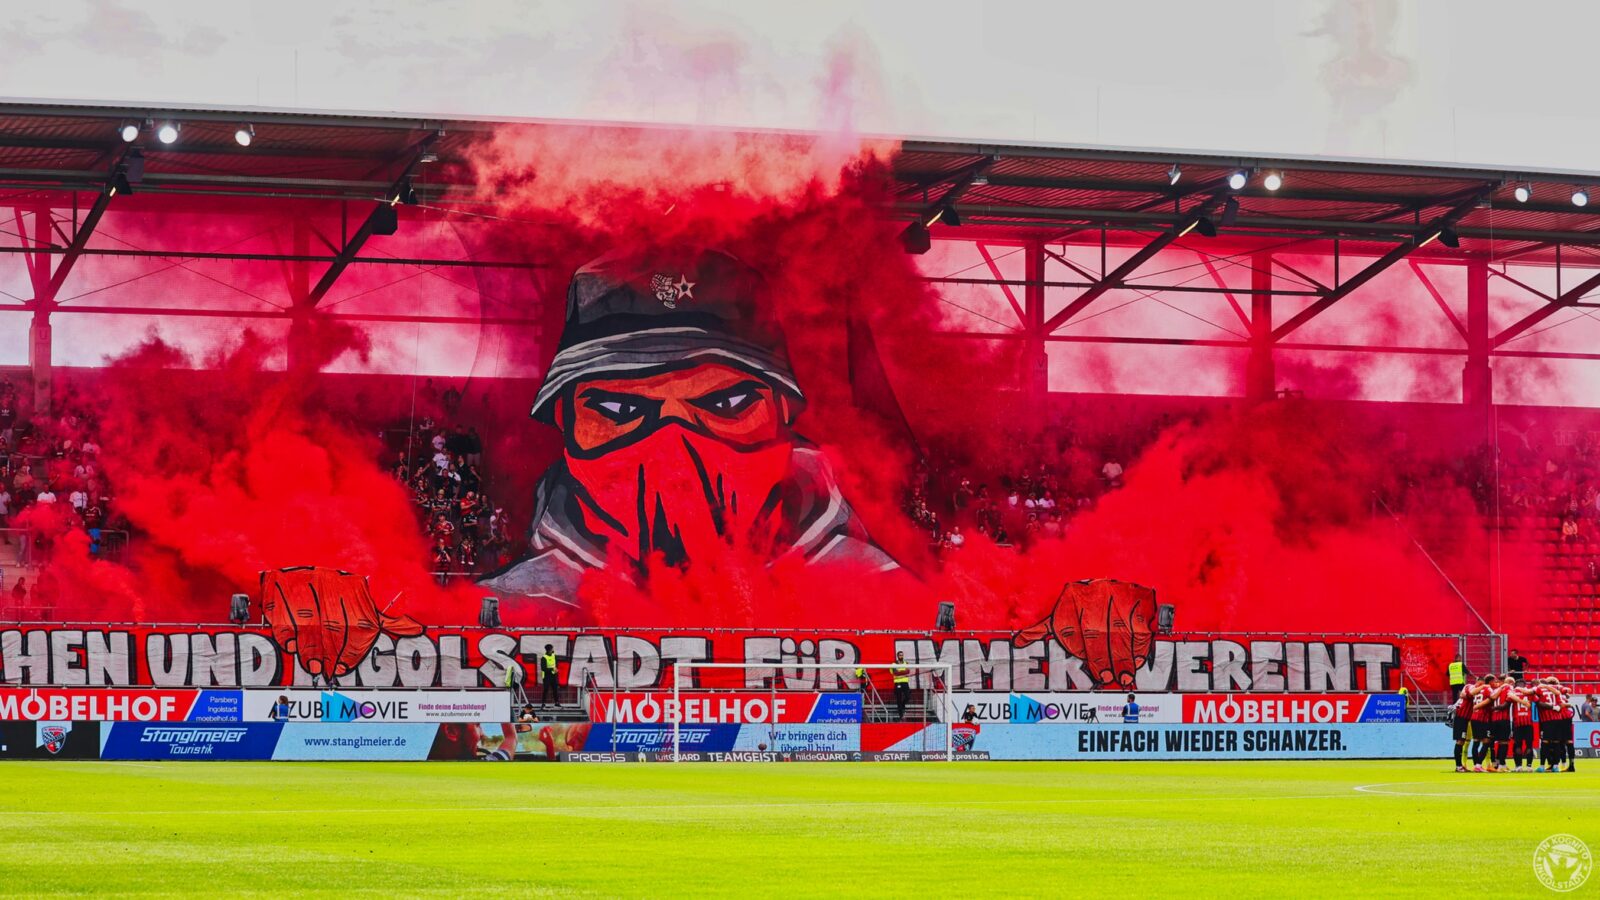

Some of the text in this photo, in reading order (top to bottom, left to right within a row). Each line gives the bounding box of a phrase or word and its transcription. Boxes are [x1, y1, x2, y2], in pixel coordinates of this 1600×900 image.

[146, 632, 281, 686] UND
[293, 632, 709, 688] GOLSTADT
[1134, 639, 1397, 692] VEREINT
[209, 696, 237, 704] Parsberg
[340, 701, 409, 719] MOVIE
[453, 703, 487, 711] Ausbildung!
[1026, 702, 1089, 720] MOVIE
[1192, 693, 1350, 723] MÖBELHOF
[140, 727, 249, 744] Stanglmeier
[768, 731, 848, 742] Wir bringen dich
[1078, 729, 1348, 753] EINFACH WIEDER SCHANZER.
[304, 736, 407, 748] www.stanglmeier.de
[169, 743, 214, 754] Touristik
[707, 752, 777, 762] TEAMGEIST
[795, 752, 848, 761] hildeGUARD
[873, 752, 910, 761] guSTAFF
[921, 752, 989, 761] produke.prosis.de
